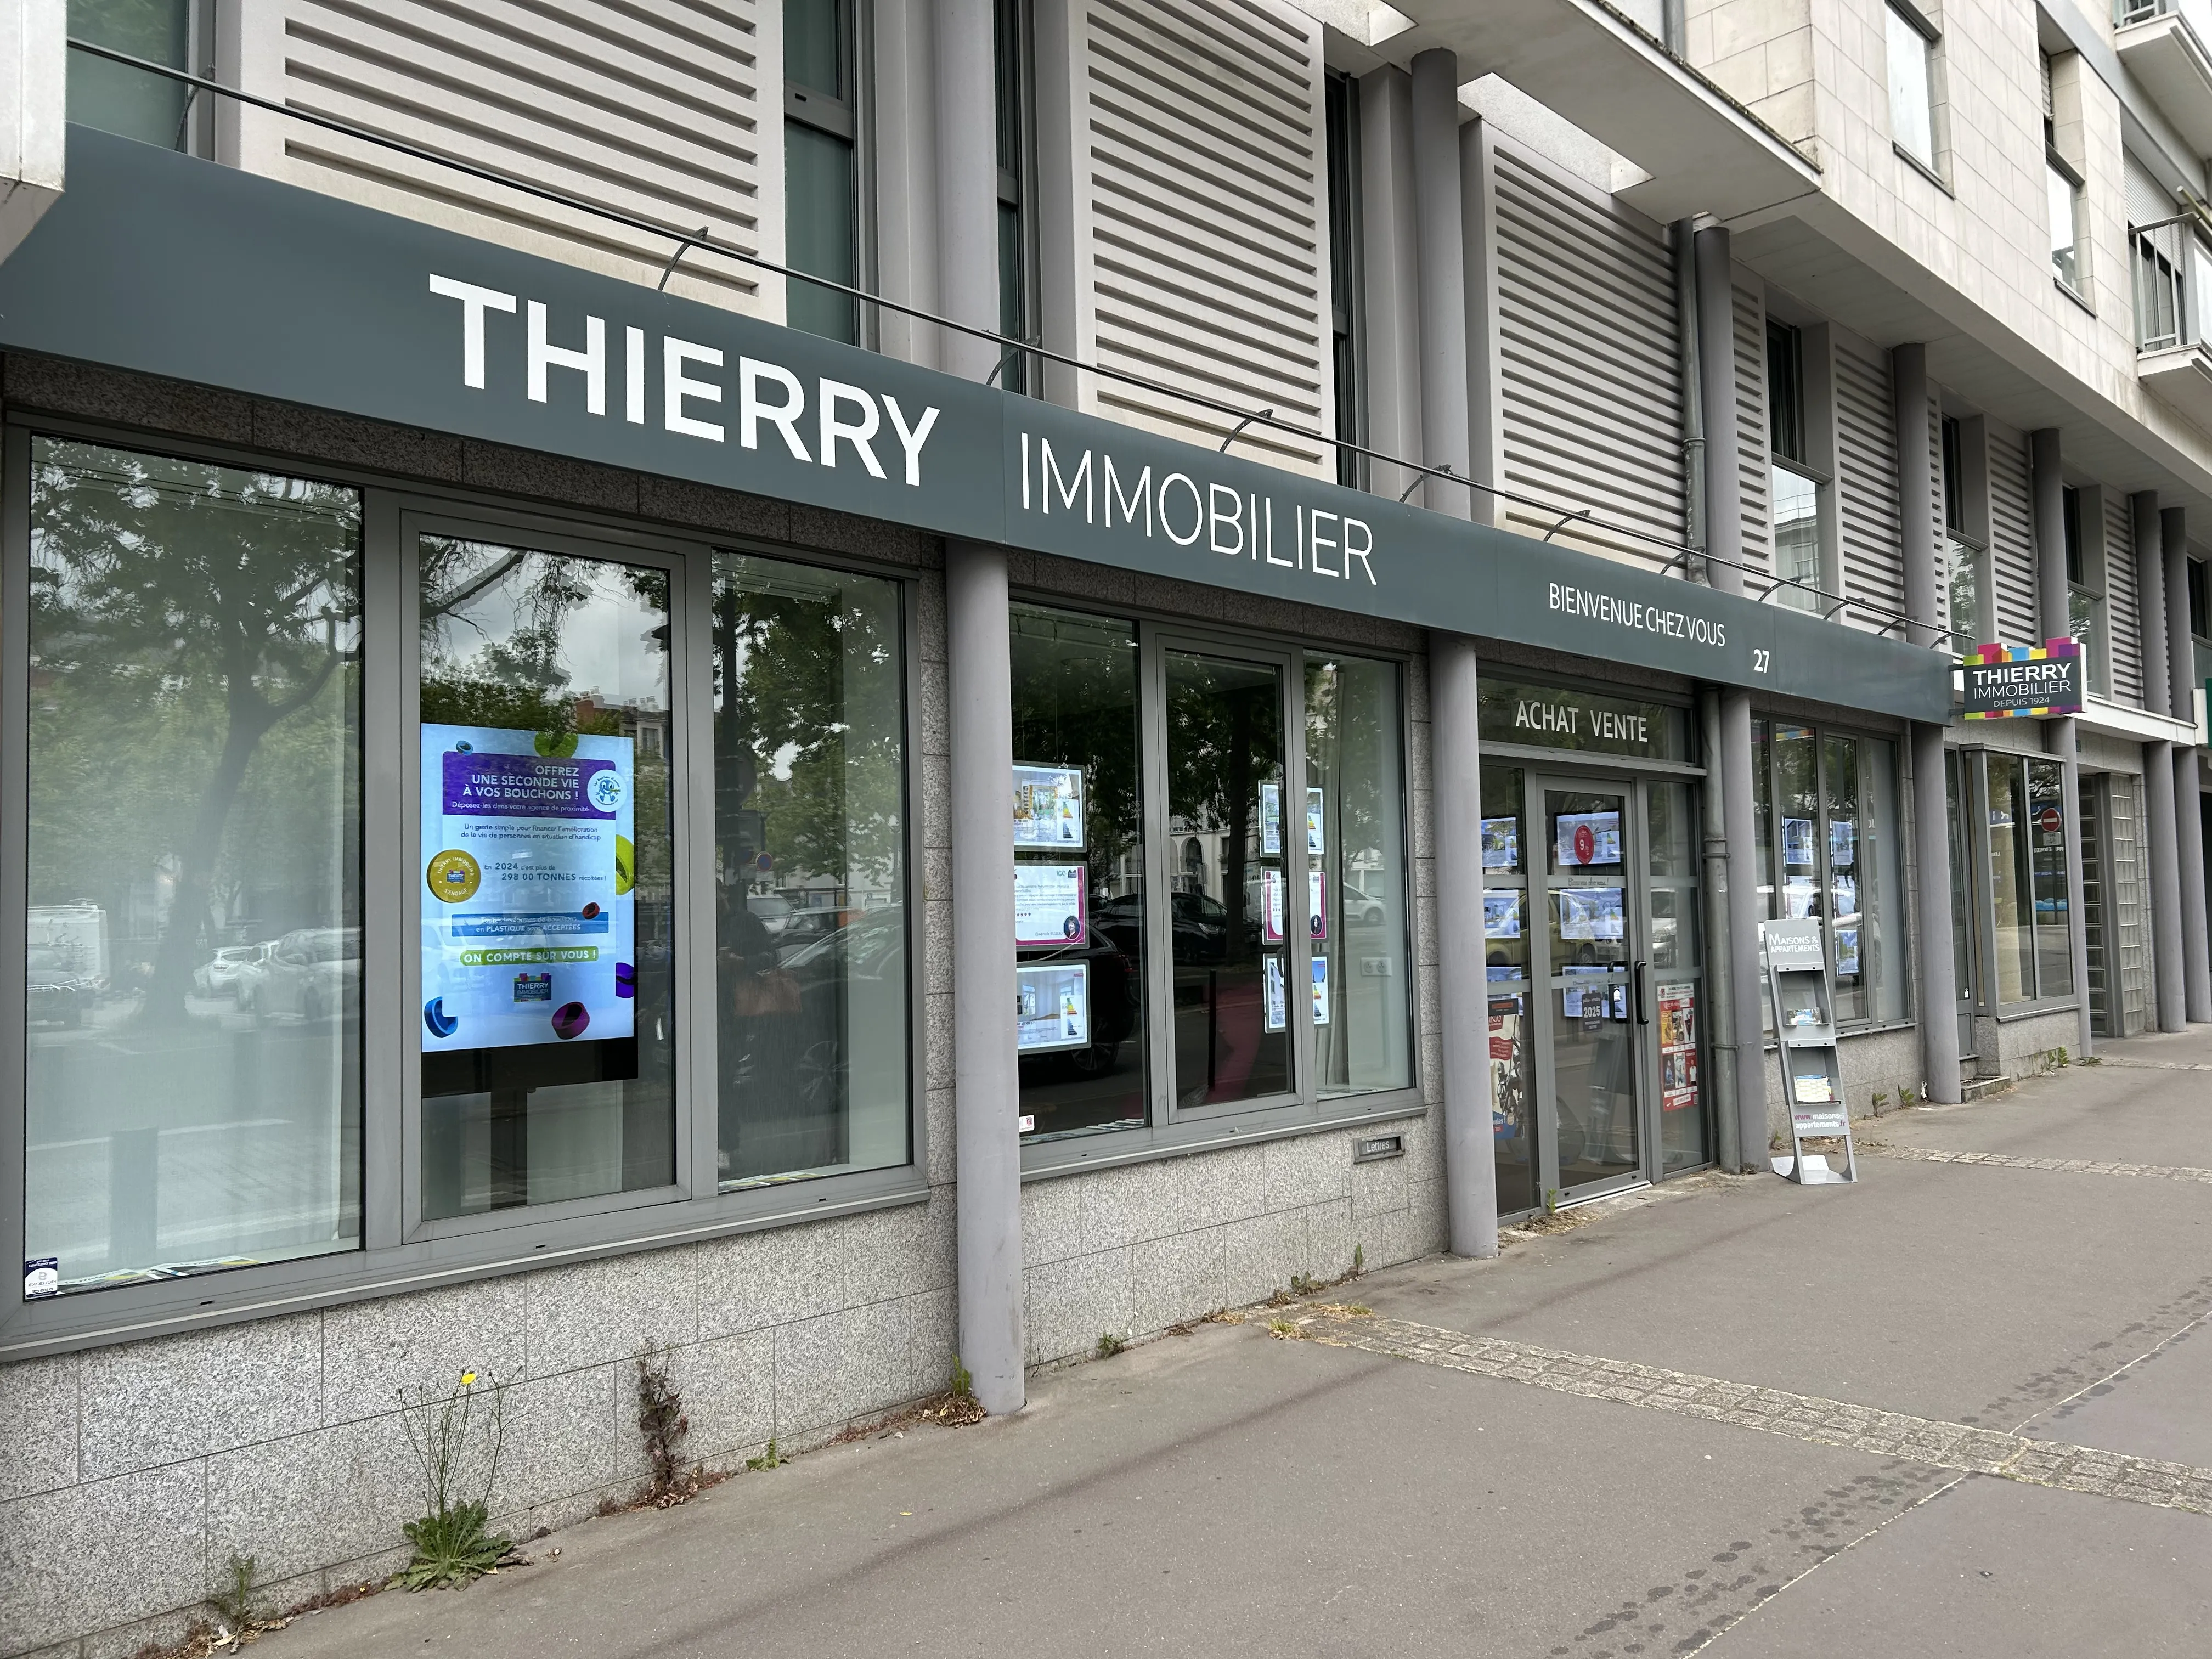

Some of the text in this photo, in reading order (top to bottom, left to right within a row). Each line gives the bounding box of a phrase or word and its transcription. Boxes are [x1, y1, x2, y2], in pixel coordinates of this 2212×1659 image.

[429, 273, 1377, 585] THIERRY IMMOBILIER
[1549, 582, 1725, 647] BIENVENUE CHEZ VOUS
[1753, 648, 1770, 673] 27
[1972, 662, 2072, 686] THIERRY
[1974, 680, 2072, 699] IMMOBILIER
[1994, 696, 2050, 708] DEPUIS 1924
[1515, 700, 1647, 742] ACHAT VENTE
[535, 765, 579, 776] OFFREZ
[472, 775, 579, 788] UNE SECONDE VIE
[462, 785, 578, 800] À VOS BOUCHONS !
[452, 802, 491, 810] Déposez-les
[569, 833, 601, 842] d'handicap
[444, 888, 468, 896] S'ENGAGE
[1770, 944, 1820, 953] APPARTEMENTS
[464, 950, 596, 963] ON COMPTE SUR VOUS !
[1583, 1006, 1600, 1018] 2025
[1796, 1120, 1846, 1130] appartements.fr
[1367, 1141, 1390, 1152] Lettres
